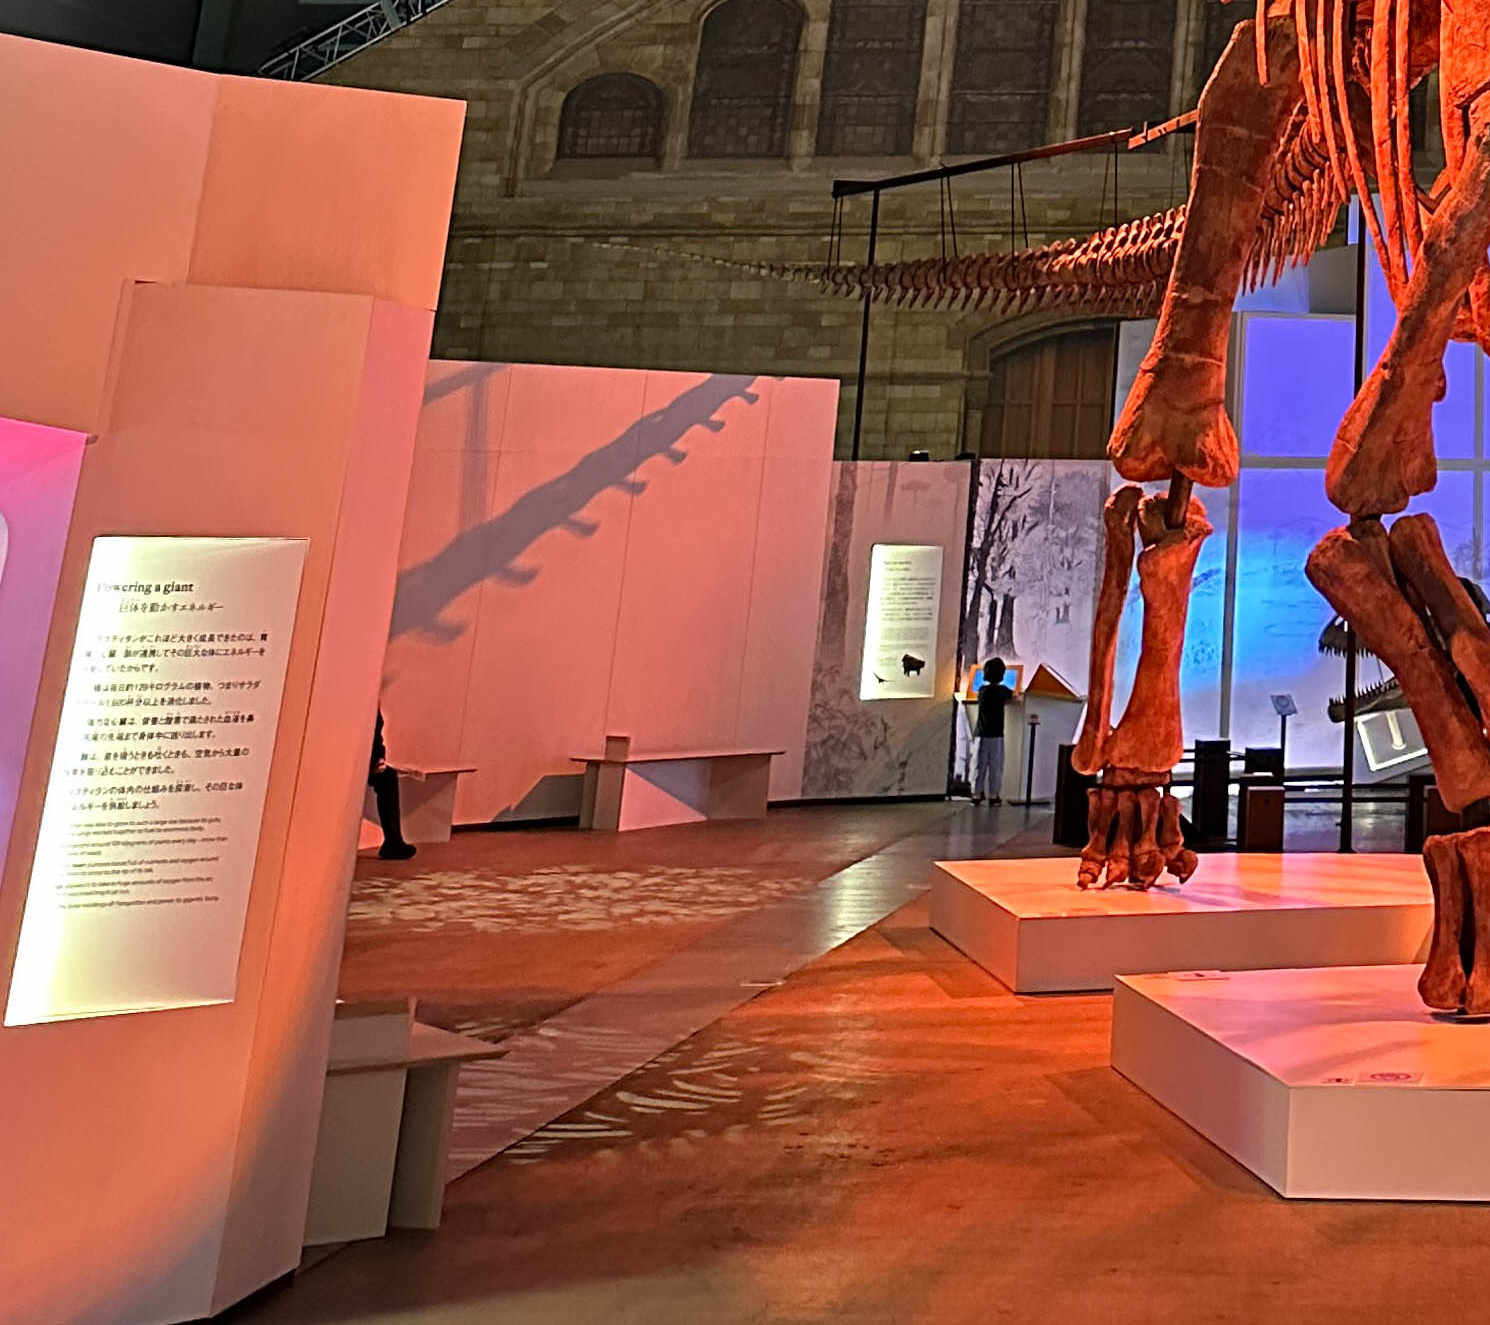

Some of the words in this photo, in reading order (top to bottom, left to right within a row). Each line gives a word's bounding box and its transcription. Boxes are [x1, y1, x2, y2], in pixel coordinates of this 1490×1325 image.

[97, 582, 153, 595] Powering
[154, 584, 161, 593] a
[163, 581, 194, 595] giant
